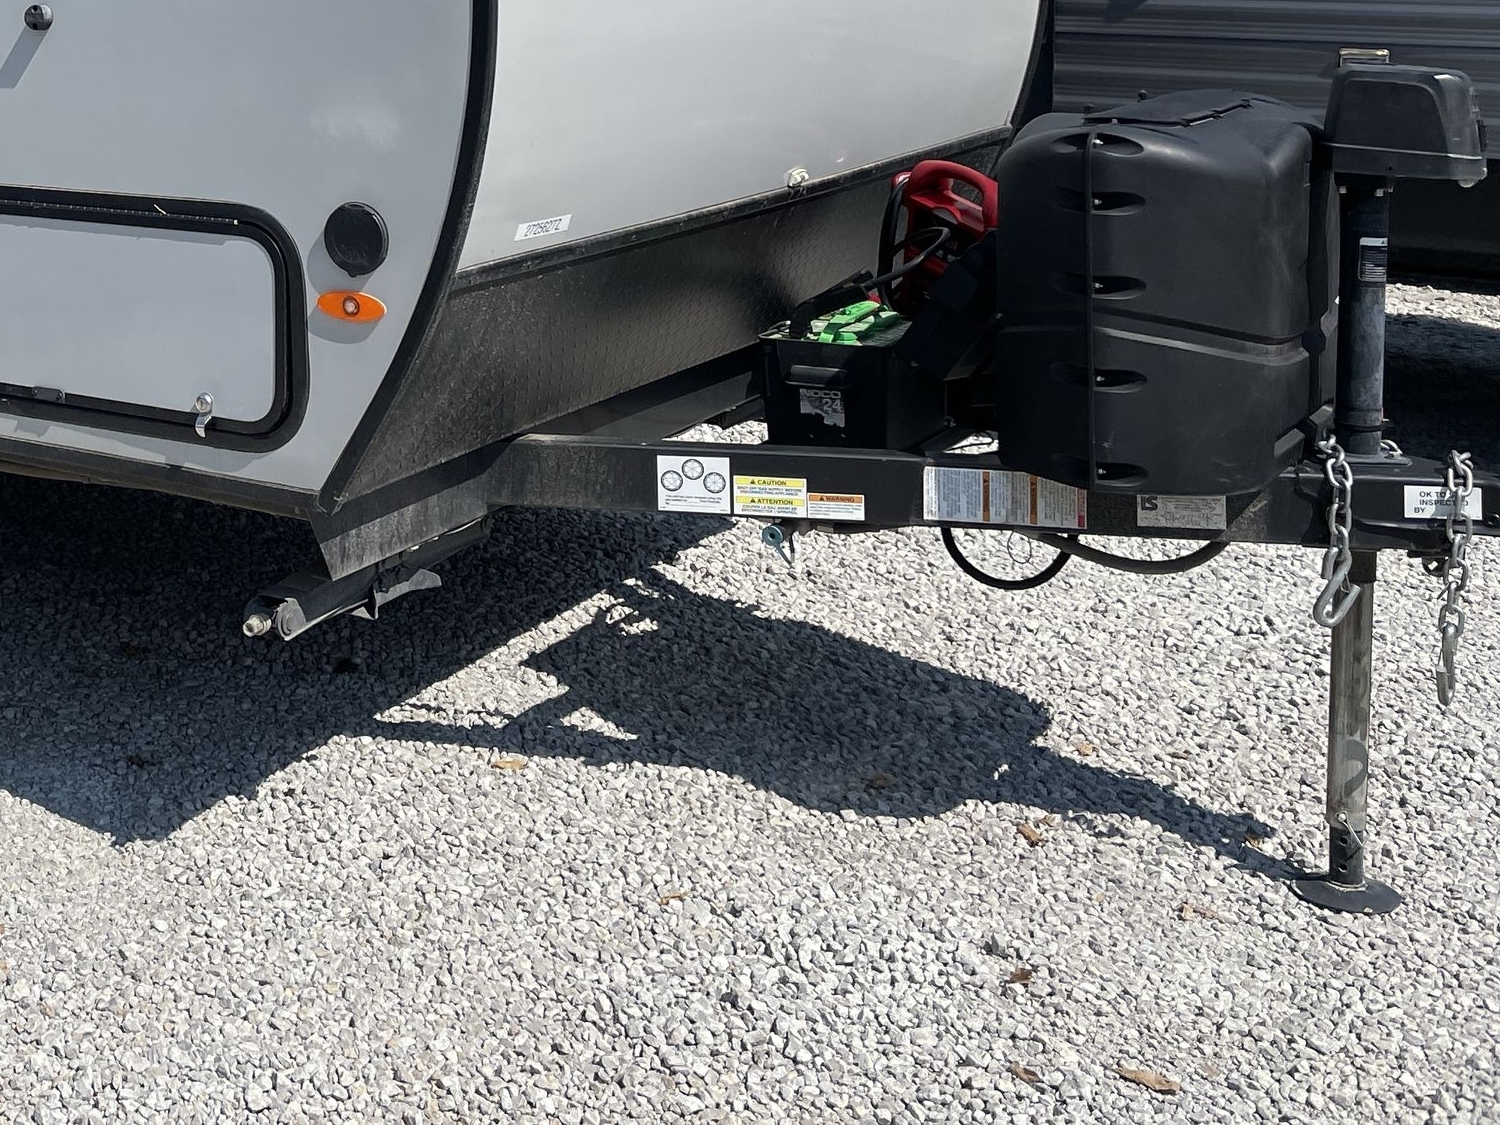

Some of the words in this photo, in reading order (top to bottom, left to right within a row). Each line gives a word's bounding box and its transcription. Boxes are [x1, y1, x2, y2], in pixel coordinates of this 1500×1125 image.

[1419, 490, 1433, 498] OK
[1419, 499, 1469, 507] INSPECTD
[1413, 506, 1426, 514] BY
